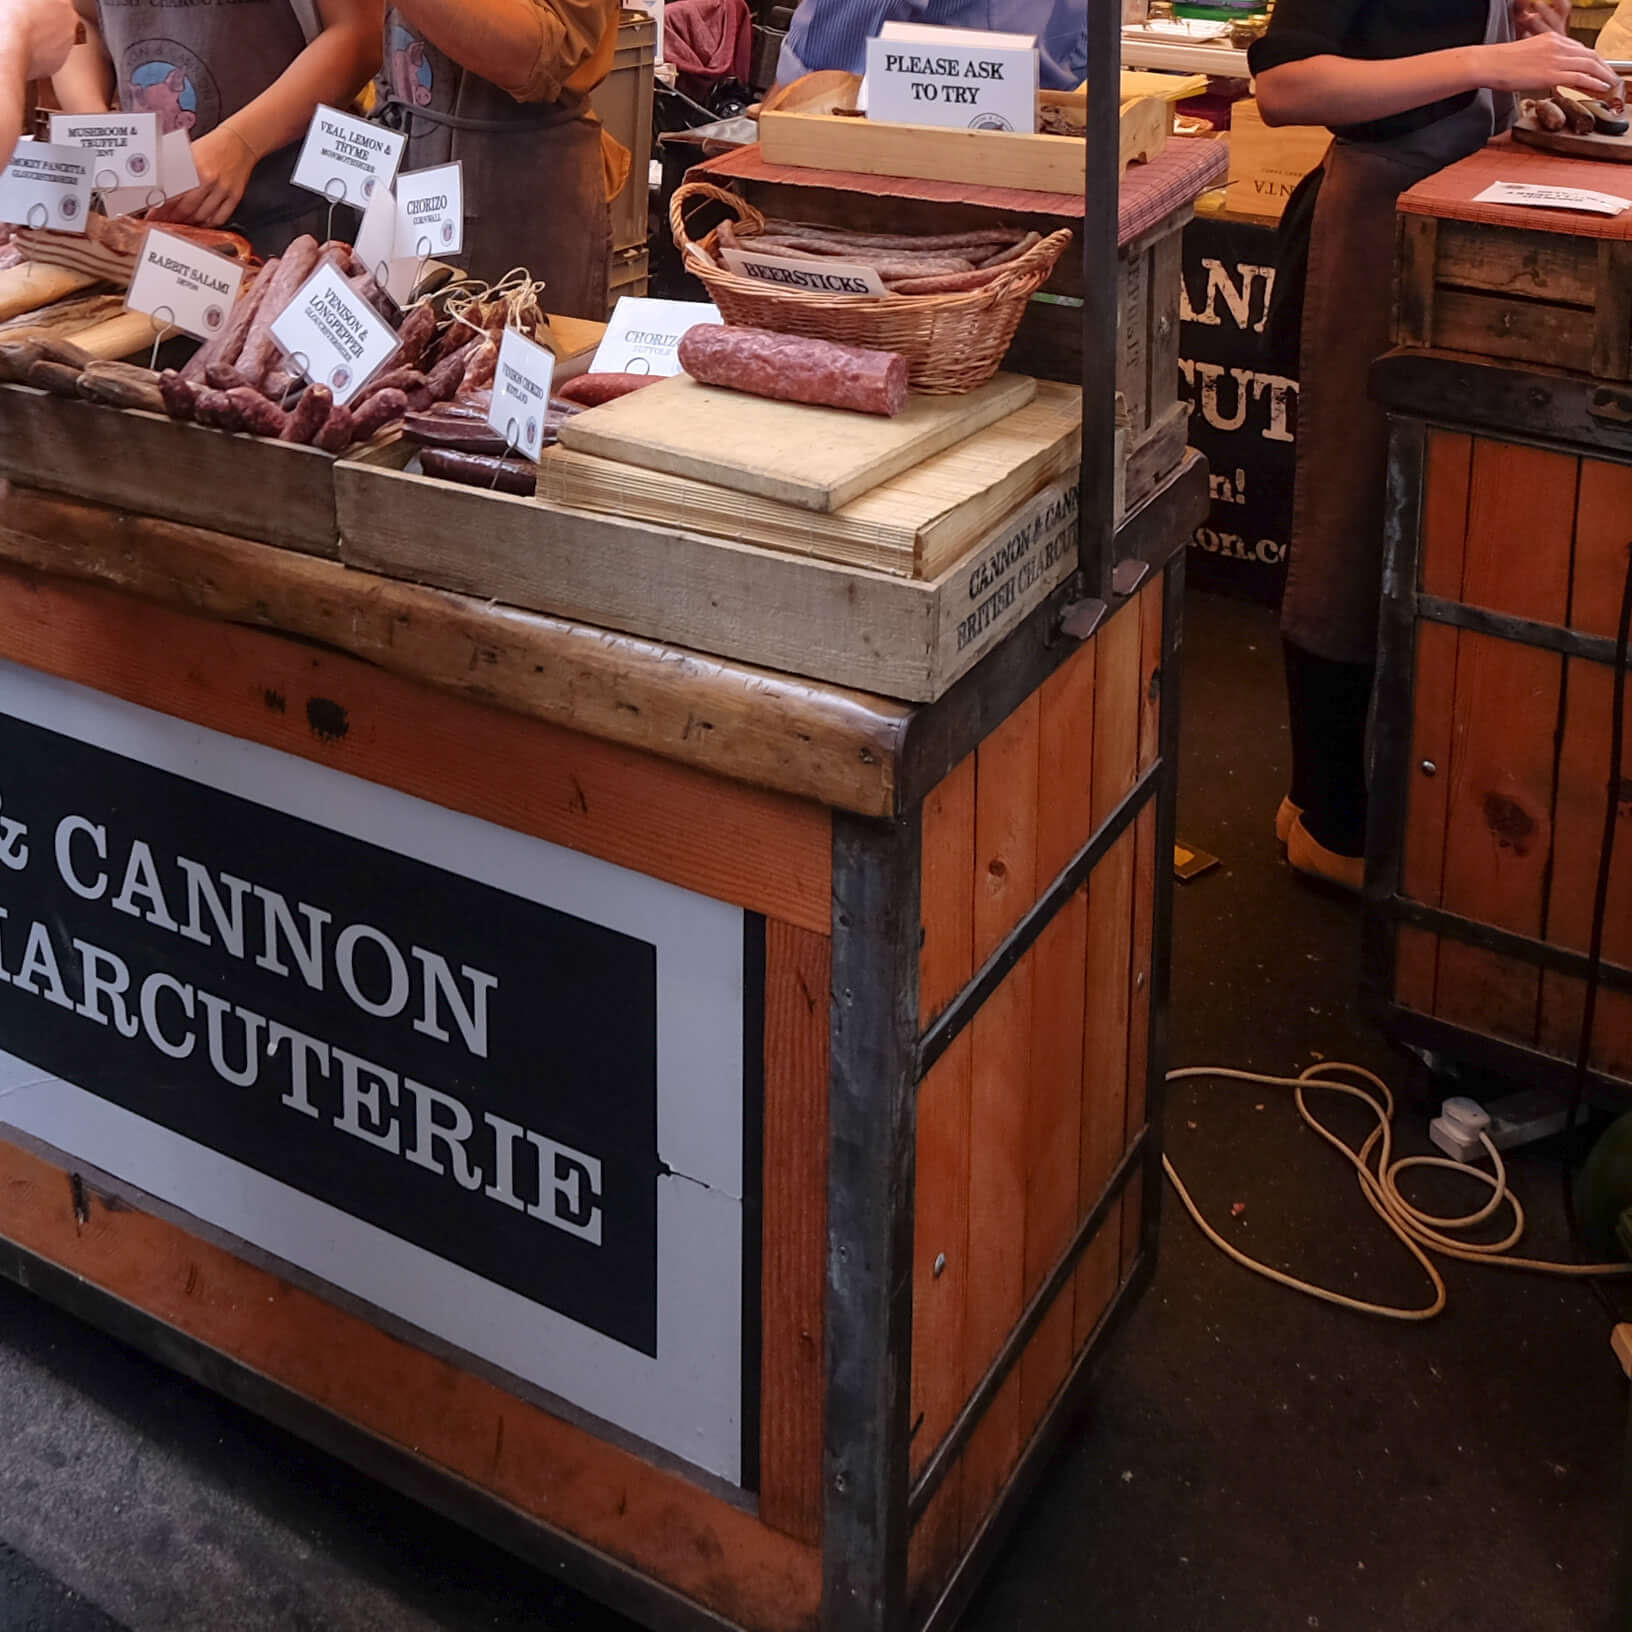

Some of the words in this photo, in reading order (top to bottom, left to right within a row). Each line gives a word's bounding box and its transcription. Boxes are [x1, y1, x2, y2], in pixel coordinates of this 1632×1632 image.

[885, 54, 960, 78] PLEASE
[963, 60, 1005, 80] ASK
[911, 82, 938, 101] TO
[942, 85, 981, 105] TRY
[67, 126, 129, 138] MUSHROOM
[129, 126, 138, 136] &
[79, 137, 128, 148] TRUFFLE
[320, 120, 348, 142] VEAL,
[348, 131, 384, 153] LEMON
[383, 144, 393, 156] &
[96, 149, 115, 157] ENT
[335, 139, 370, 162] THYME
[12, 157, 42, 168] MOKEY
[42, 160, 87, 175] PANCETTA
[406, 194, 448, 216] CHORIZO
[146, 251, 192, 278] RABBIT
[189, 269, 231, 295] SALAMI
[741, 261, 870, 294] BEERSTICKS
[308, 294, 366, 360] LONGPEPPER
[323, 287, 362, 336] VENISON
[358, 330, 369, 343] &
[624, 329, 680, 347] CHORIZ
[969, 523, 1032, 601] CANNON
[1044, 485, 1080, 533] CANN
[956, 574, 1017, 652] BRITISH
[1017, 518, 1080, 596] CHARCUT
[53, 814, 499, 1060] CANNON
